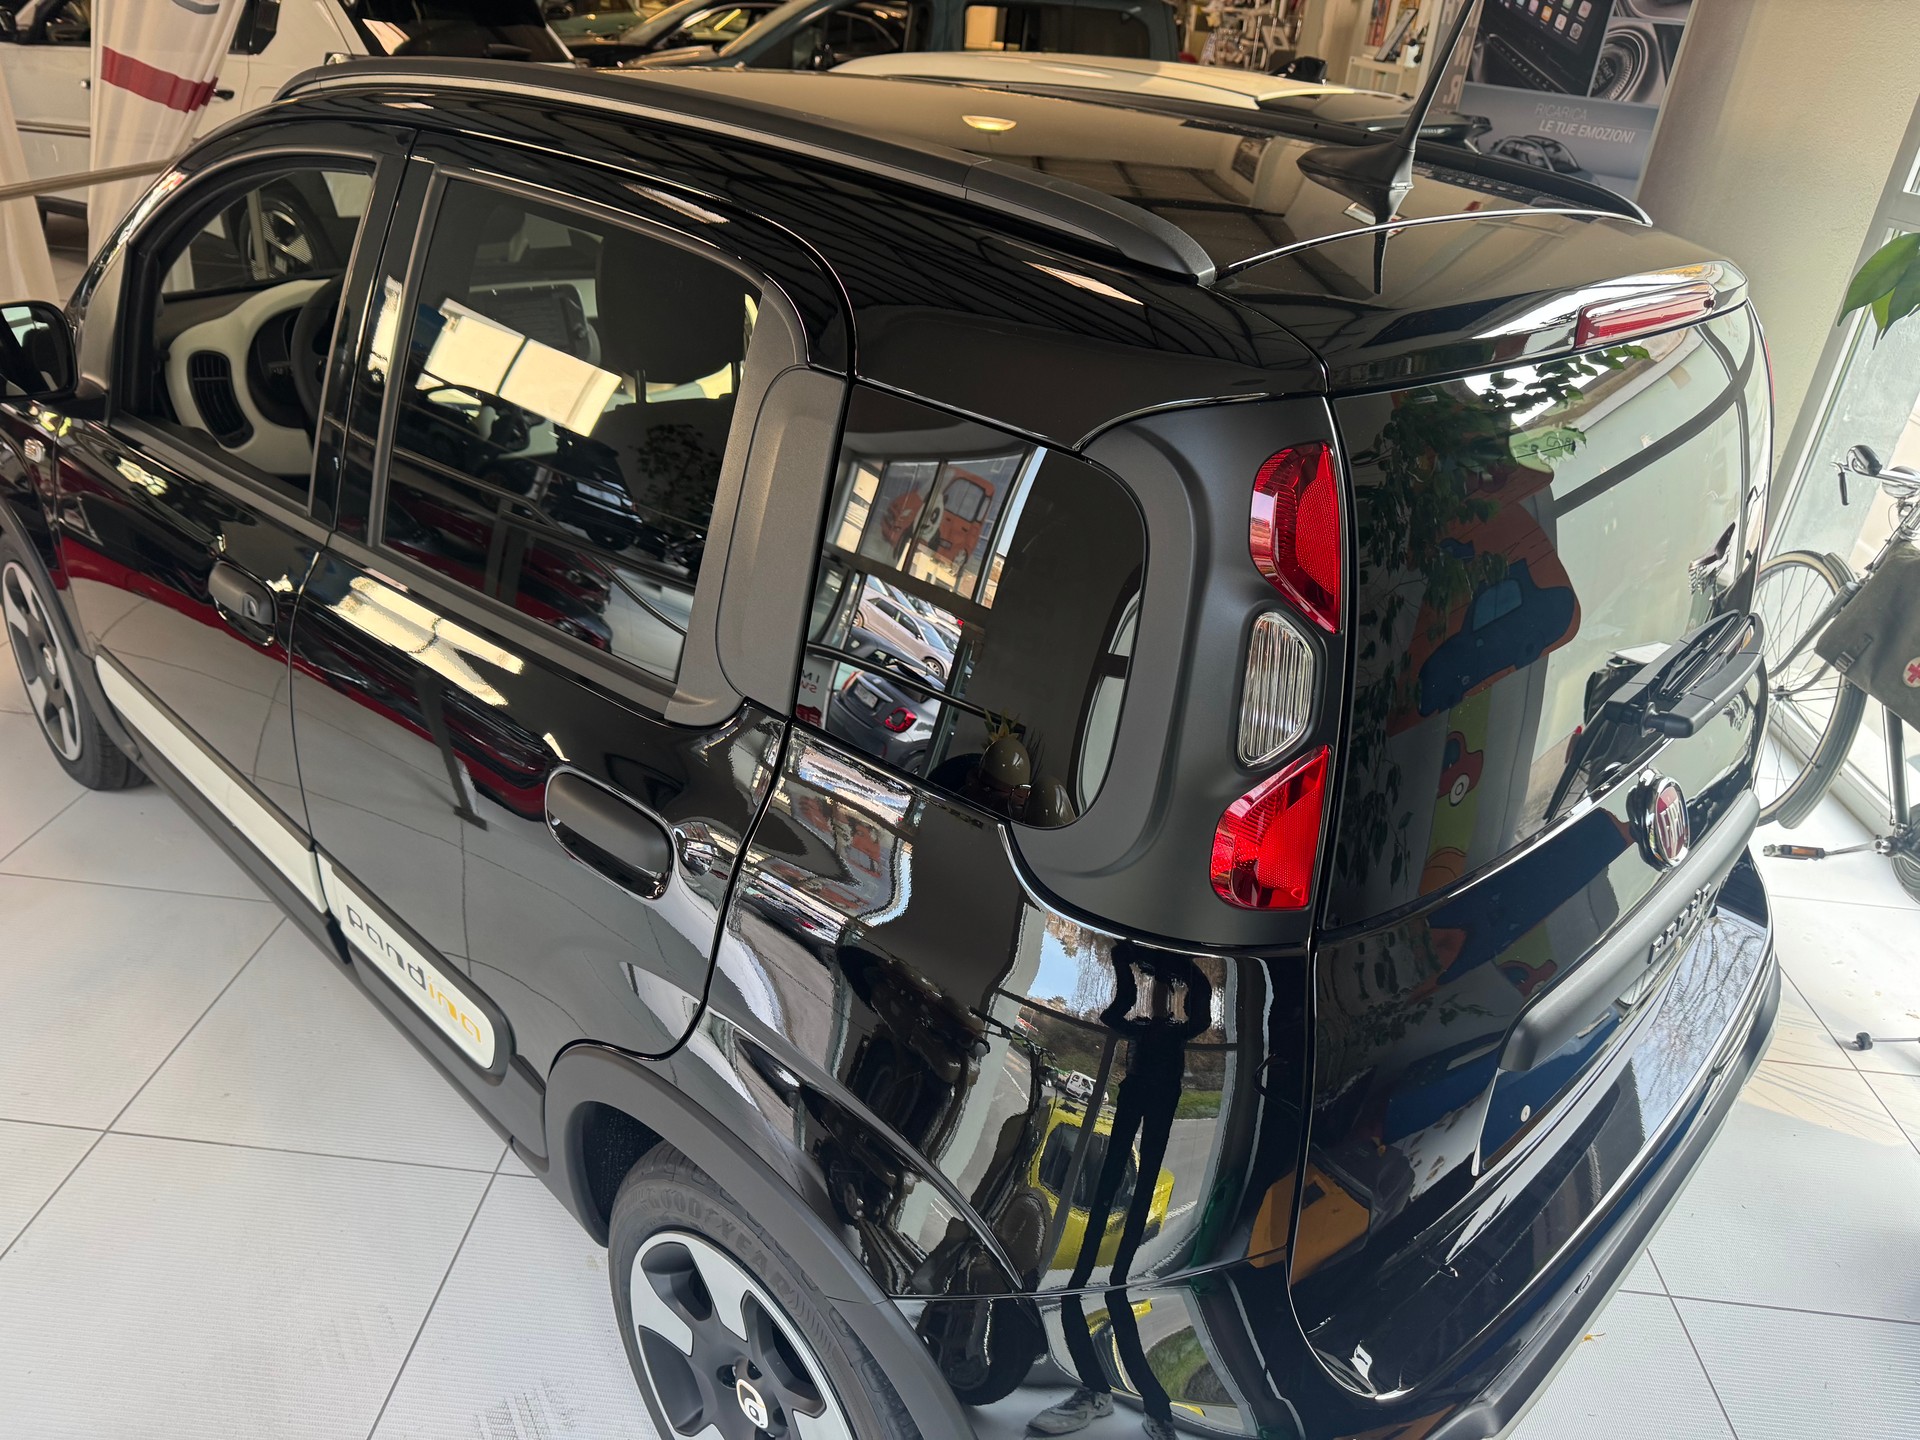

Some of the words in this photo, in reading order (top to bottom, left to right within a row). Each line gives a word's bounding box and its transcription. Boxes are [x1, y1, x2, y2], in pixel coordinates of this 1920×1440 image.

[1535, 103, 1588, 121] RICARICA
[1538, 119, 1555, 133] LE
[1556, 121, 1578, 136] TUE
[1578, 124, 1636, 144] EMOZIONI
[346, 904, 482, 1044] pandina
